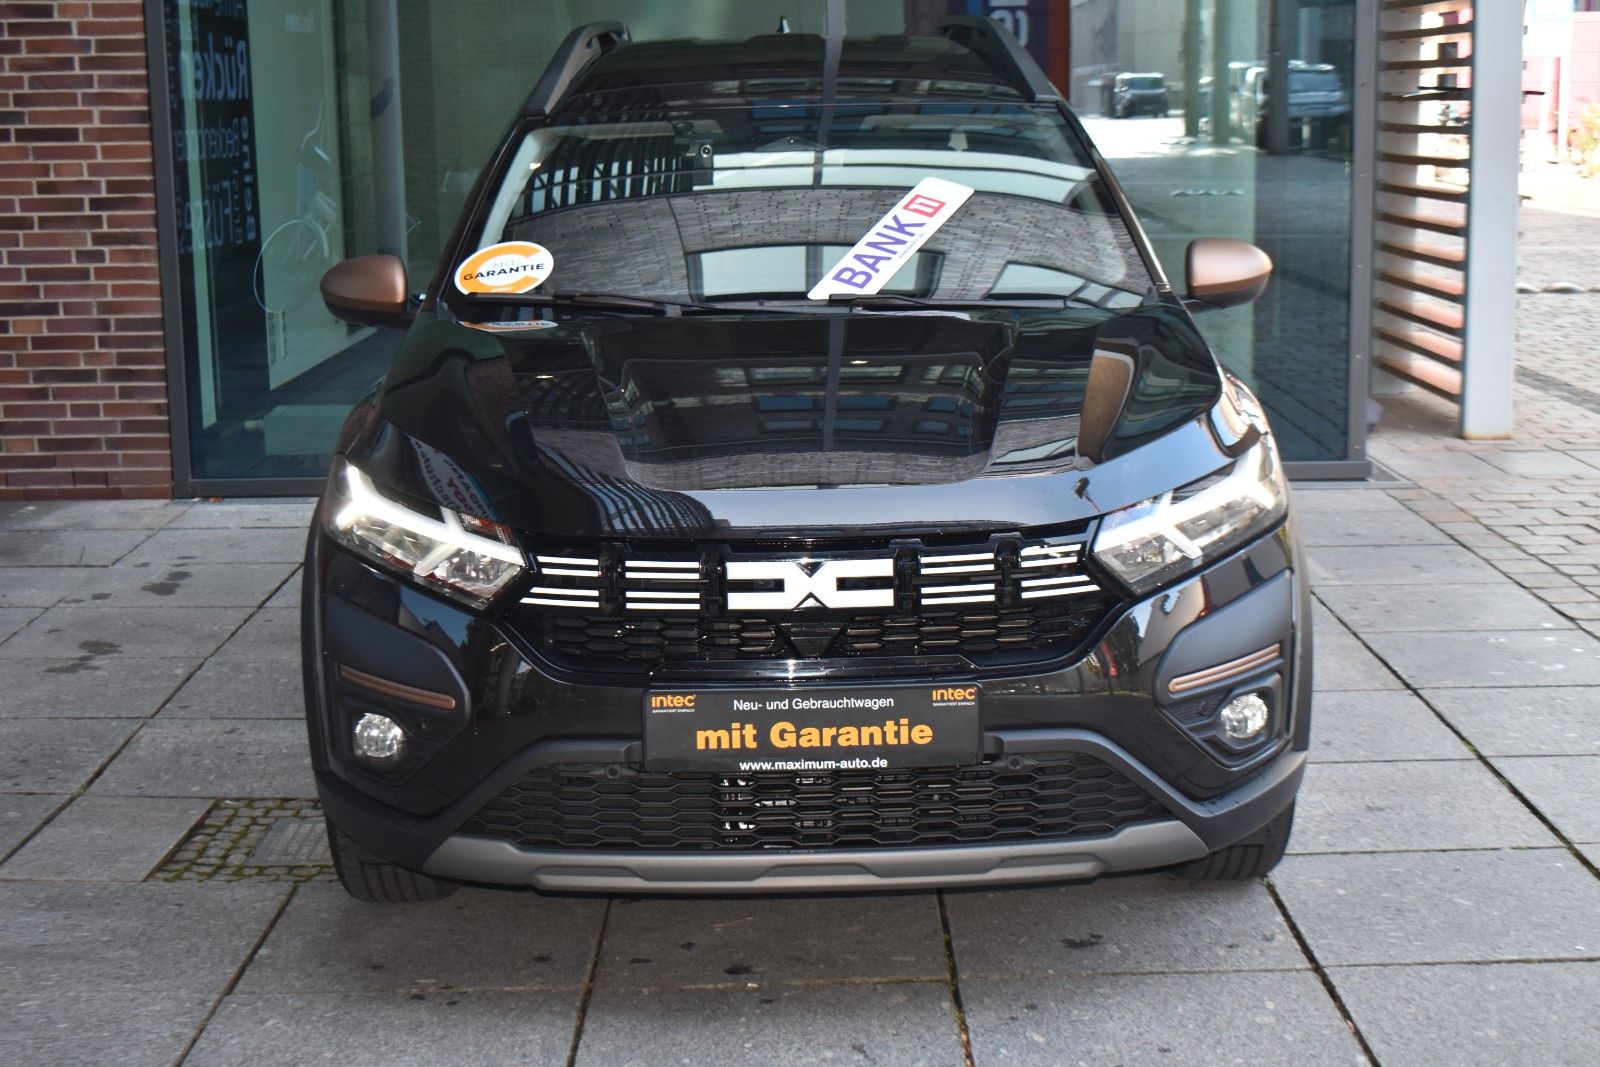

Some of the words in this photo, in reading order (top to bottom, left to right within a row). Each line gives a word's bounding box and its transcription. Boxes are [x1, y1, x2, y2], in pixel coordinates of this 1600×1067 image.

[832, 215, 927, 289] BANK
[463, 263, 545, 281] GARANTIE
[651, 694, 695, 707] intec
[932, 687, 976, 701] intec
[733, 699, 763, 711] Neu-
[766, 698, 789, 710] und
[792, 696, 894, 711] Gebrauchtwagen
[696, 722, 758, 750] mit
[770, 718, 933, 749] Garantie
[739, 757, 888, 771] www.maximum-auto.de
